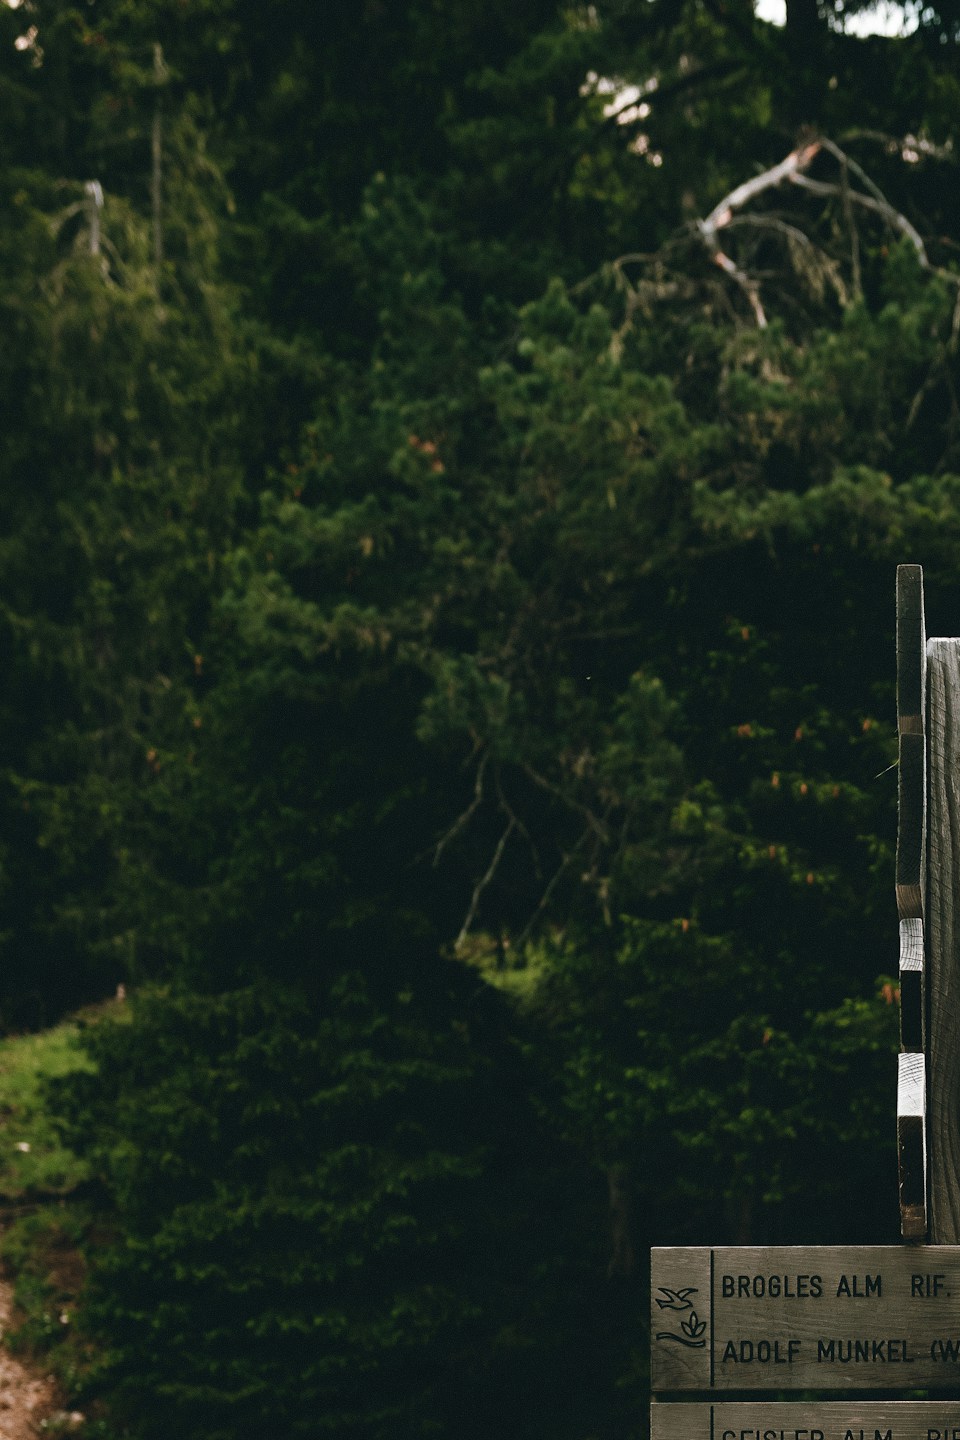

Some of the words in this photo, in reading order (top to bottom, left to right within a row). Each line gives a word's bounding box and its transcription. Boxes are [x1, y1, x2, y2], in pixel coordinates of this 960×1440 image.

[722, 1274, 823, 1298] BROGLES
[836, 1274, 883, 1298] ALM
[911, 1274, 951, 1298] RIF.
[721, 1340, 802, 1364] ADOLF
[817, 1339, 915, 1363] MUNKEL
